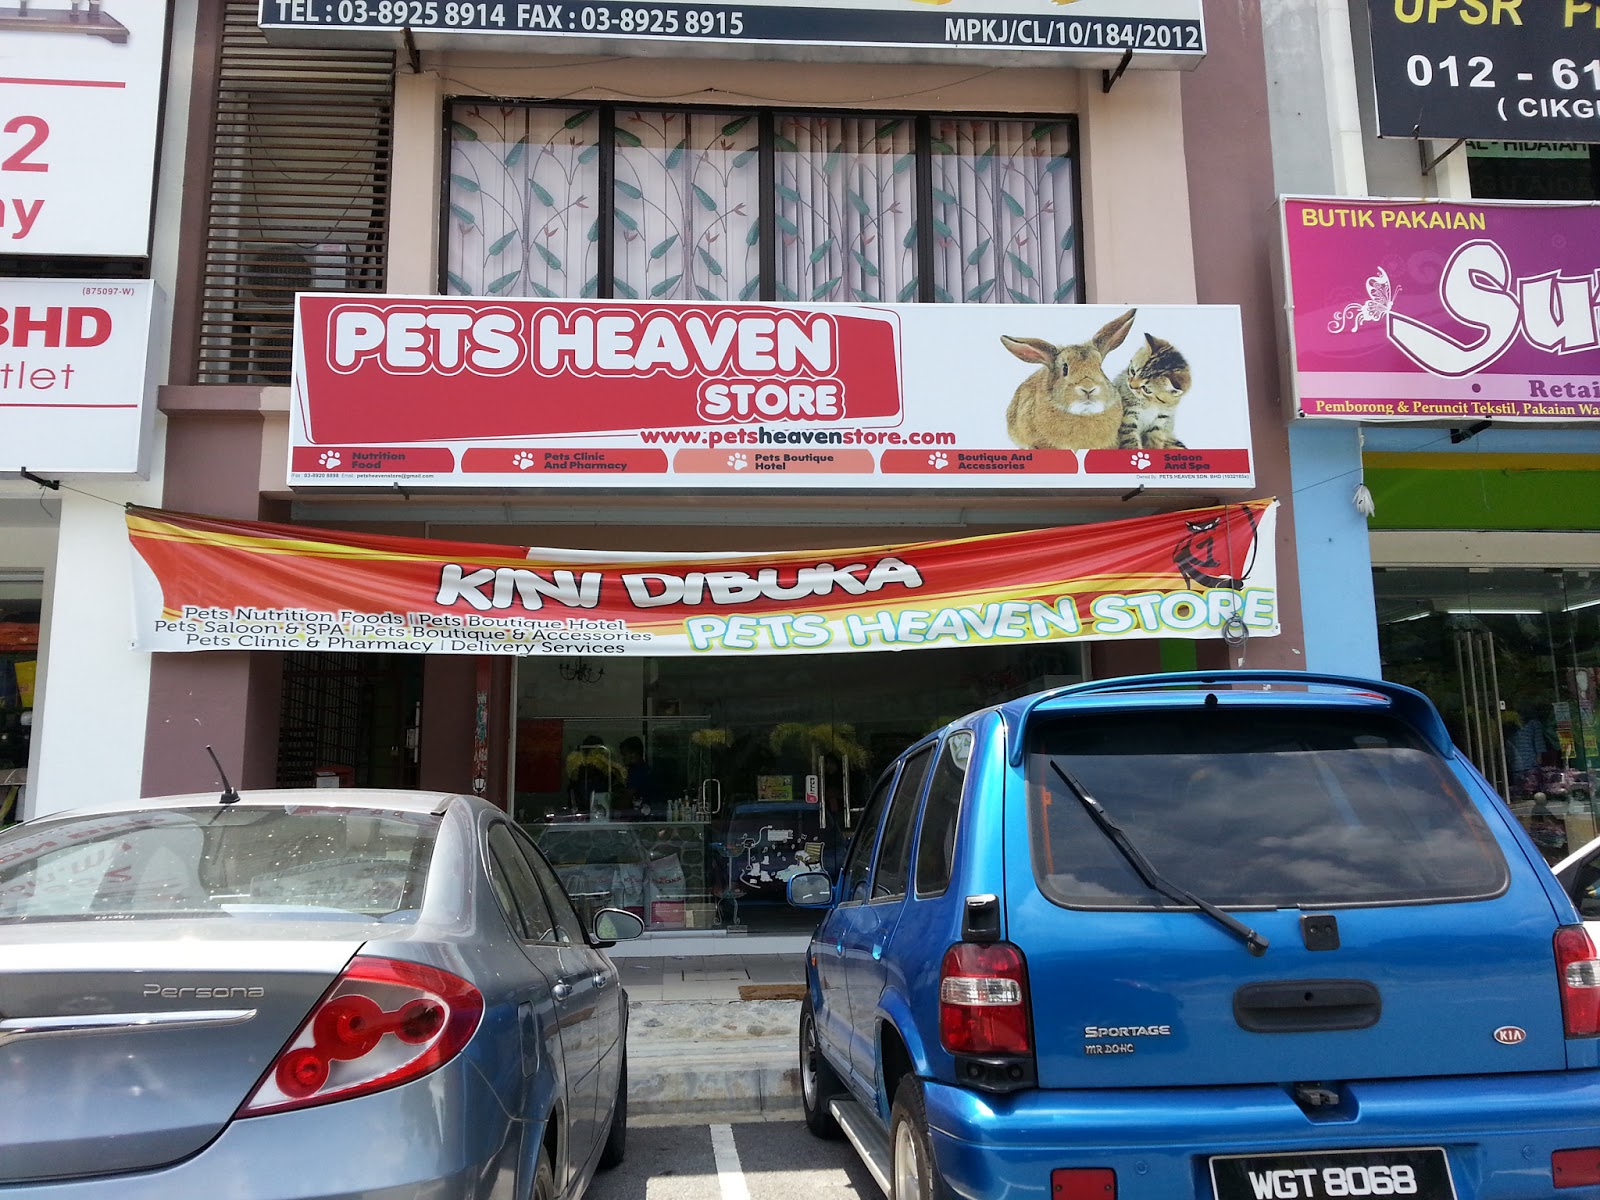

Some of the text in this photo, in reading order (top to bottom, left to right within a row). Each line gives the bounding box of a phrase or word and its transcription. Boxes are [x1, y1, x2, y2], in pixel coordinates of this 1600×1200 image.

[337, 0, 438, 26] 03-8925
[443, 1, 506, 28] 8914
[580, 6, 679, 34] 03-8925
[684, 8, 744, 36] 8915
[1393, 0, 1600, 29] UPSR P
[944, 18, 1200, 49] MPKJ/CL/10/184/2012
[1406, 54, 1496, 88] 012
[1517, 97, 1600, 119] CIKG
[1301, 208, 1486, 231] BUTIK PAKAIAN
[82, 287, 135, 297] (875097-W)
[1387, 239, 1600, 379] Su
[333, 311, 833, 374] PETS HEAVEN
[702, 383, 839, 418] STORE
[1315, 400, 1395, 416] Pemborong
[1412, 401, 1469, 414] Peruncit
[1470, 402, 1521, 416] Tekstil,
[1522, 402, 1576, 415] Pakaian
[1578, 403, 1600, 415] Wa
[640, 426, 957, 449] www.petsheavenstore.com
[351, 451, 406, 461] Nutrition
[351, 460, 382, 469] Food
[544, 452, 605, 461] Pets Clinic
[544, 461, 628, 472] And Pharmacy
[754, 453, 835, 464] Pets Boutique
[754, 462, 786, 471] Hotel
[957, 453, 1034, 463] Boutique And
[957, 462, 1025, 471] Accessories
[1163, 453, 1203, 462] Saloon
[1164, 461, 1210, 471] And Spa
[434, 556, 926, 611] KINI DIBUKA
[184, 606, 229, 621] Pets
[235, 607, 334, 623] Nutrition
[340, 611, 404, 625] Foods
[418, 613, 462, 628] Pets
[468, 616, 563, 633] Boutique
[568, 619, 624, 631] Hotel
[689, 589, 1276, 652] PETS HEAVEN STORE
[154, 620, 197, 633] Pets
[203, 621, 278, 635] Saloon
[305, 623, 344, 636] SPA
[362, 624, 405, 638] Pets
[412, 627, 506, 642] Boutique
[531, 628, 652, 642] Accessories
[186, 634, 231, 647] Pets
[237, 634, 300, 648] Clinic
[328, 636, 434, 653] Pharmacy
[451, 640, 535, 655] Delivery
[541, 641, 625, 654] Services
[143, 983, 265, 999] Persona
[1248, 1164, 1418, 1200] WGT 8068
